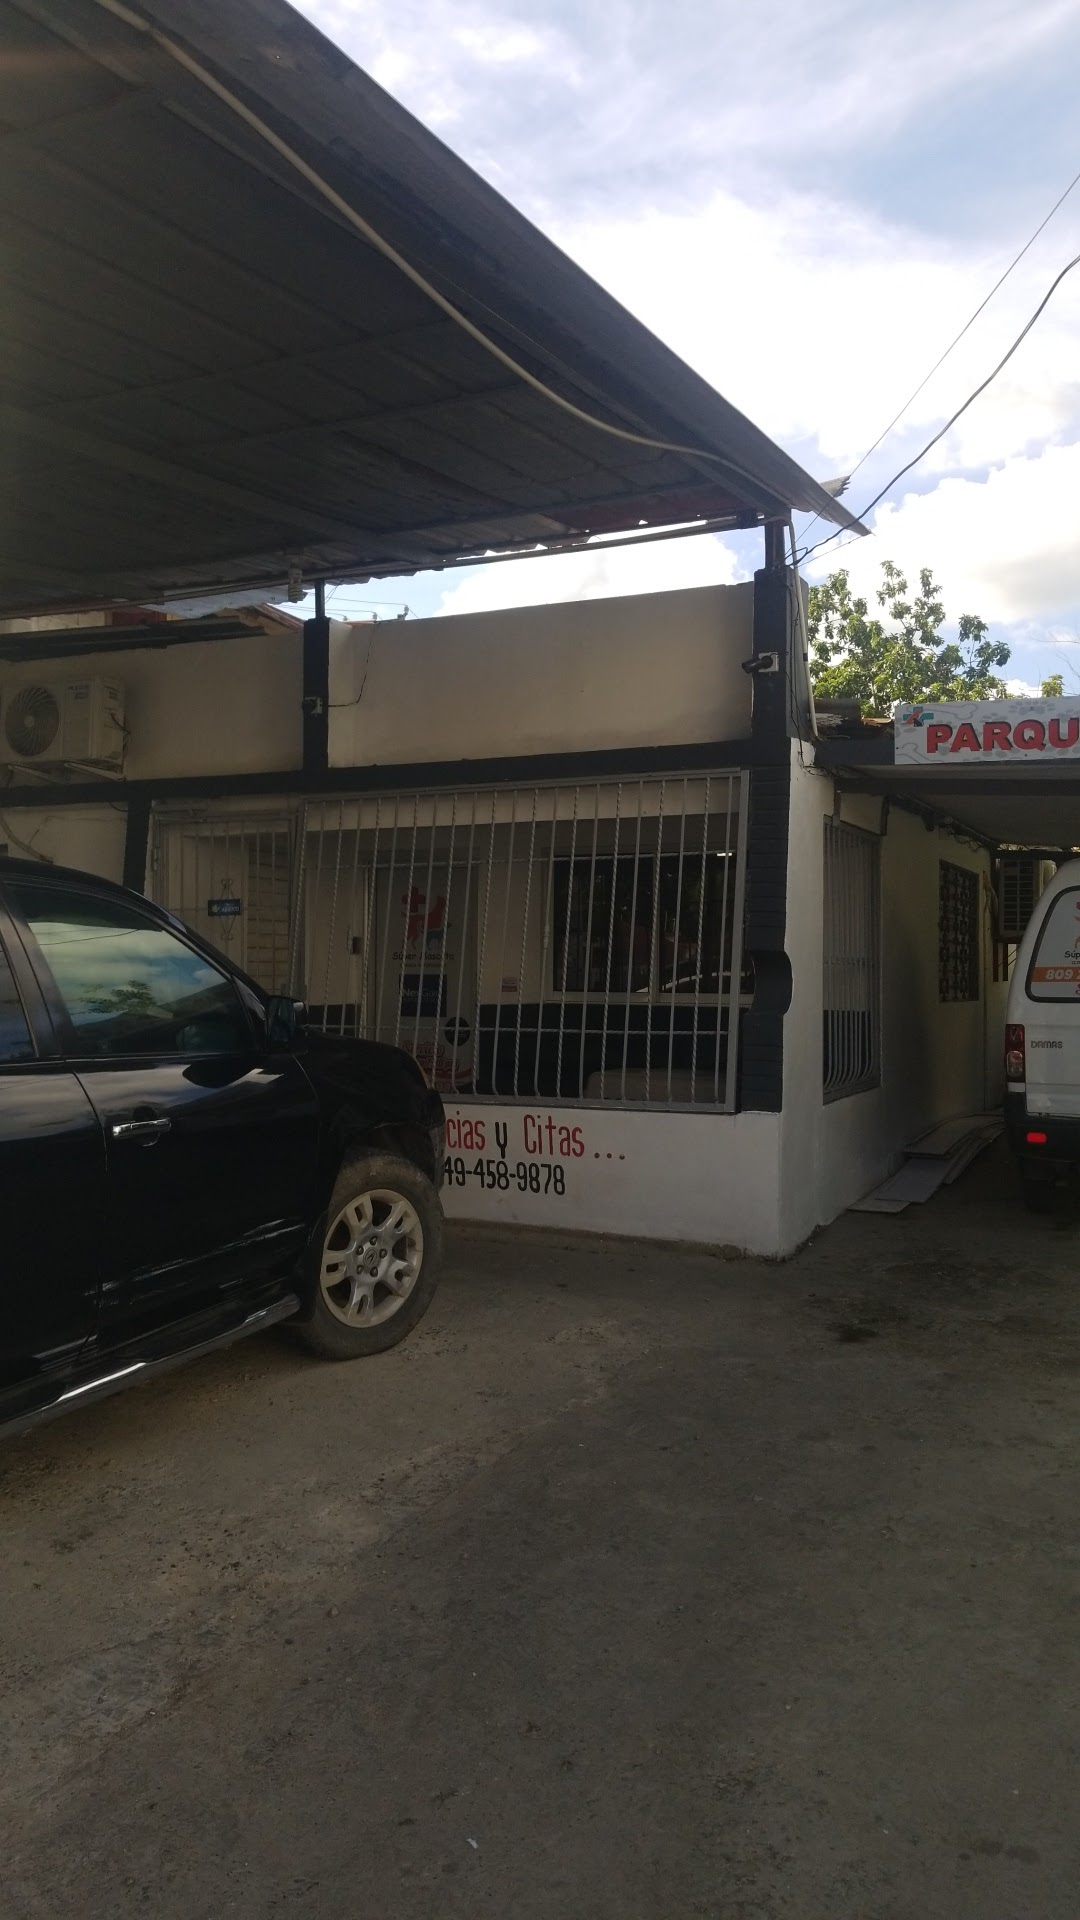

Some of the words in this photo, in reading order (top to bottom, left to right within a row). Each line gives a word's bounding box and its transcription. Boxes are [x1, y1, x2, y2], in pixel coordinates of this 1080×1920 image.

[926, 717, 1080, 754] PARQU
[1045, 969, 1074, 980] 809
[1030, 1040, 1064, 1049] DAMAS
[446, 1110, 486, 1151] cias
[494, 1121, 508, 1160] y
[444, 1155, 566, 1196] 49-458-9878
